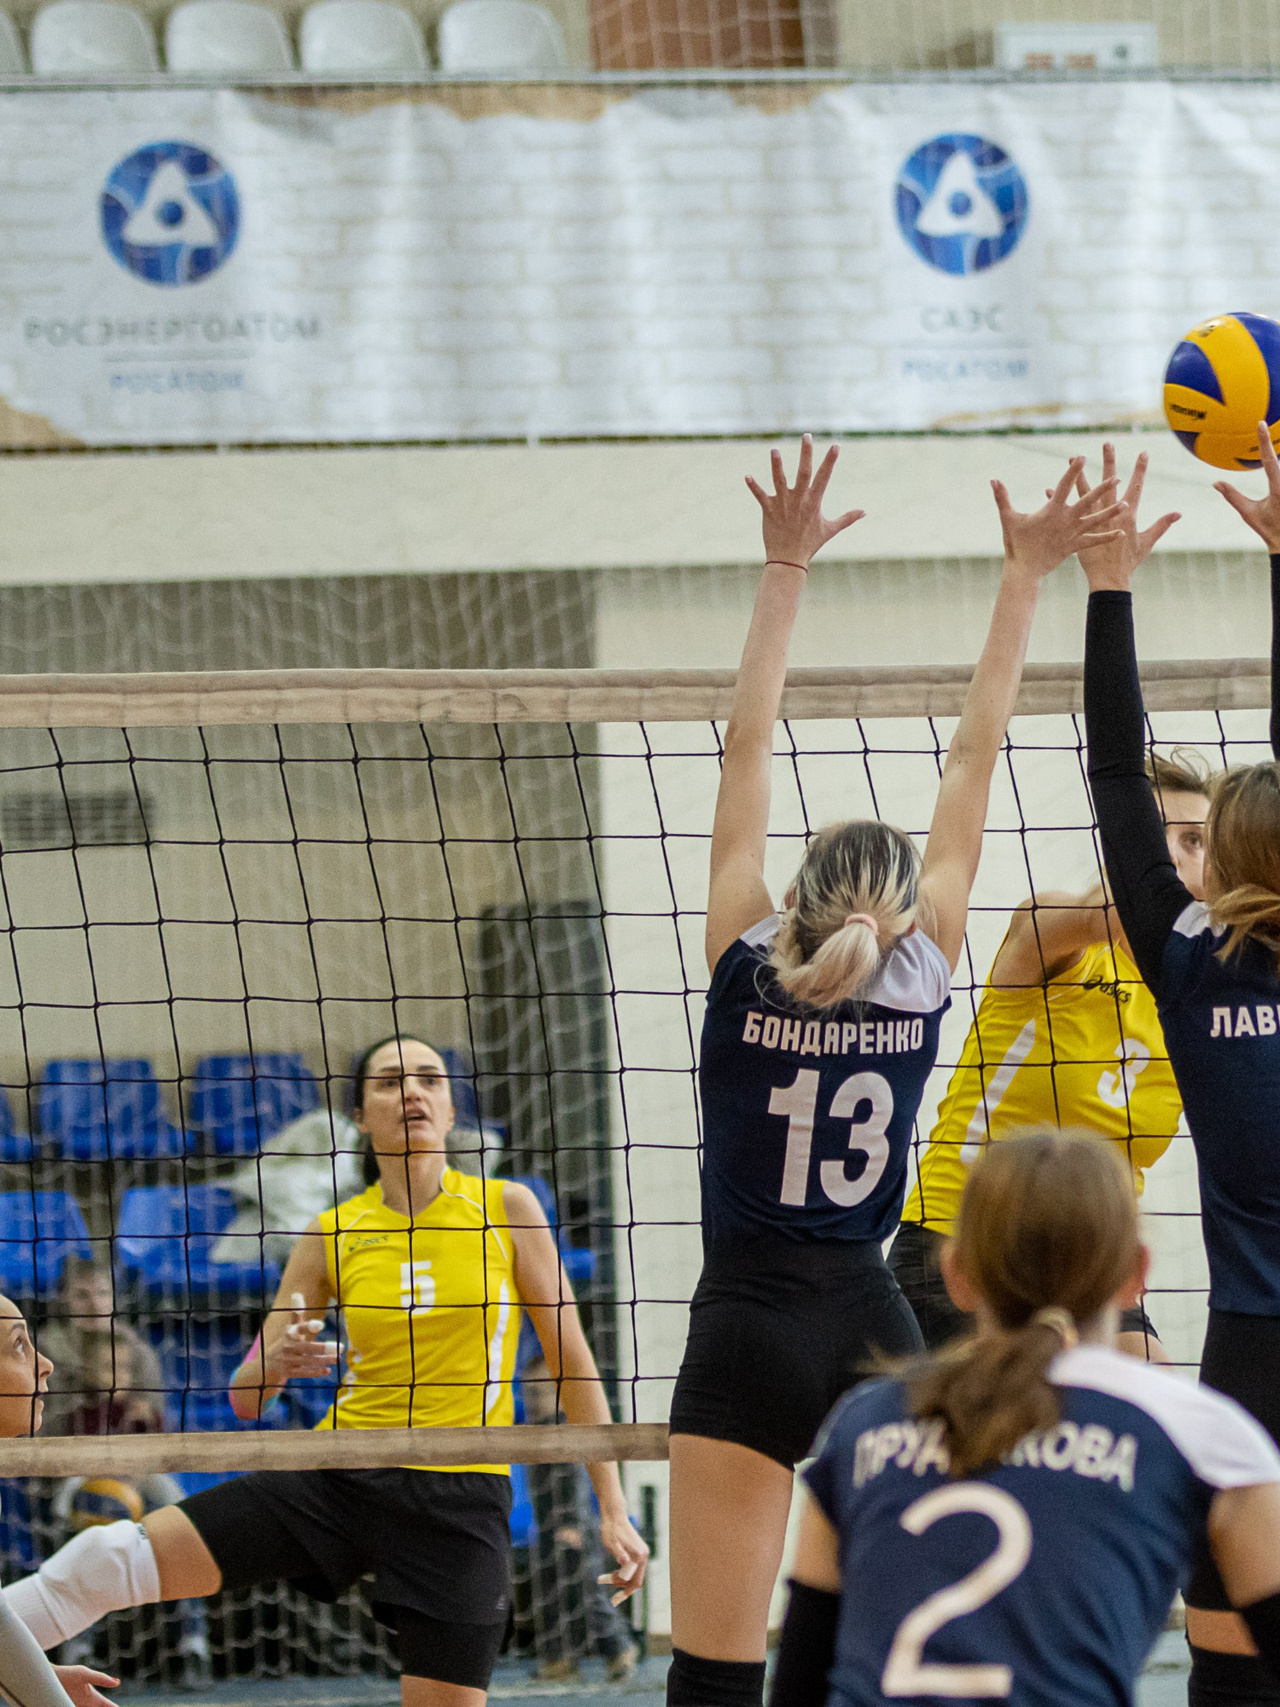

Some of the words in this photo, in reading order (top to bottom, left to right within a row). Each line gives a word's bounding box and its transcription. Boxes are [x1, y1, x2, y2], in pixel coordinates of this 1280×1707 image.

[742, 1010, 924, 1057] БОНДАРЕНКО
[1097, 1037, 1150, 1109] 3
[767, 1067, 894, 1207] 13
[400, 1260, 436, 1316] 5
[881, 1479, 1033, 1698] 2
